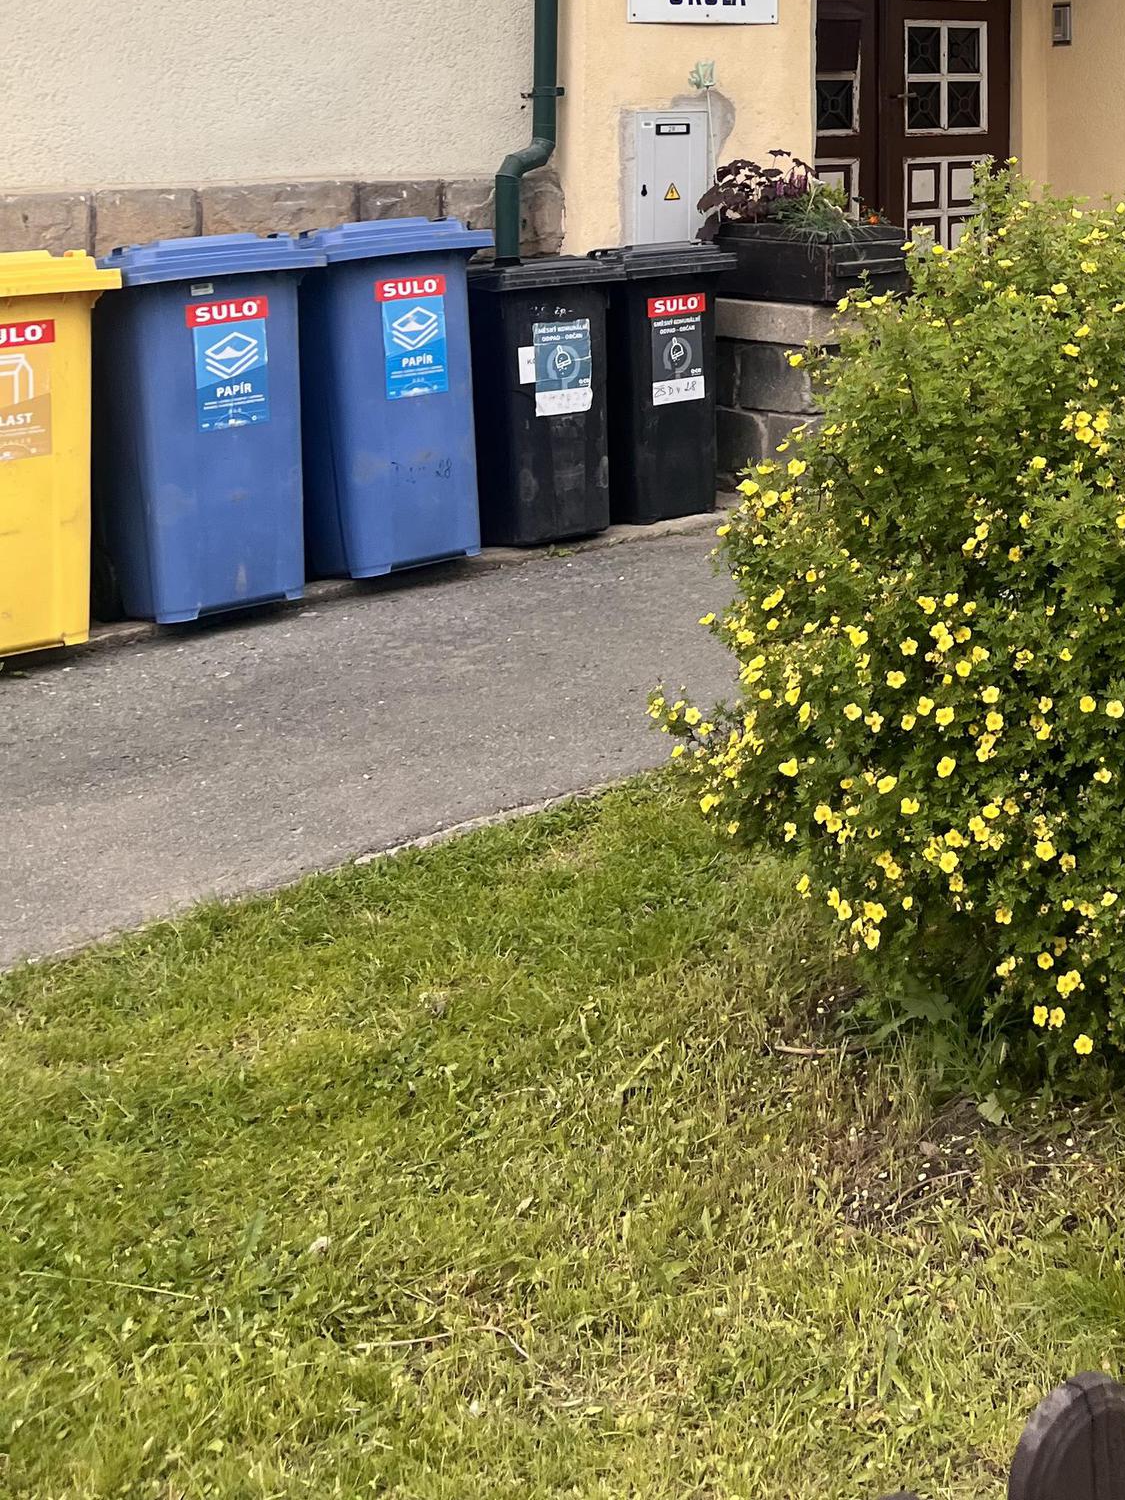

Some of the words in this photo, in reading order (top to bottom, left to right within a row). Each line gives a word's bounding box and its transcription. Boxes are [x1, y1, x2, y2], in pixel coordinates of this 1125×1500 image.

[382, 279, 437, 298] SULO
[195, 300, 258, 323] SULO
[654, 296, 698, 313] SULO
[0, 324, 43, 345] LO
[401, 353, 433, 367] PAPÍR
[216, 381, 252, 398] PAPÍR
[0, 412, 33, 426] LAST
